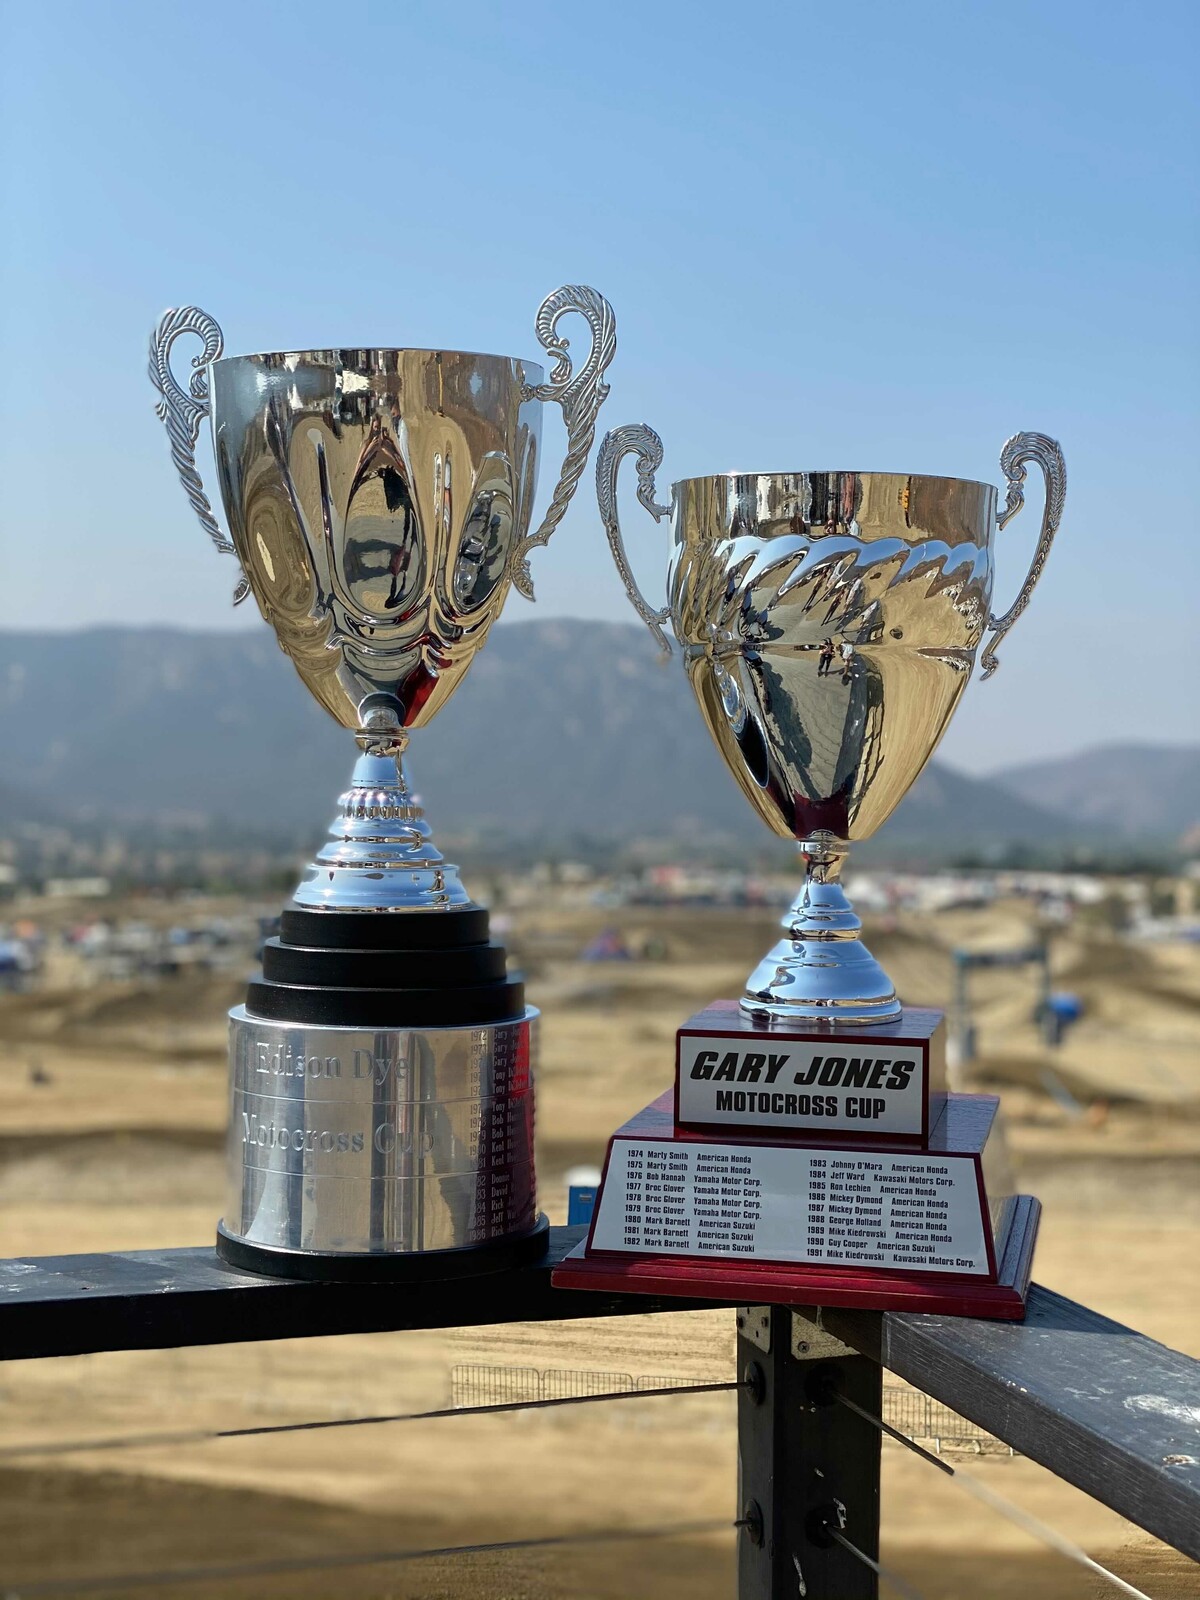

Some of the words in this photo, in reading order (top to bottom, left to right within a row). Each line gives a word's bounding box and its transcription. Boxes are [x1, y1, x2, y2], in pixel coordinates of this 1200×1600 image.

[471, 1030, 486, 1041] 1972
[256, 1042, 342, 1079] Edison
[353, 1049, 410, 1085] Dye
[493, 1056, 507, 1067] Gary
[492, 1070, 505, 1081] Tony
[690, 1051, 790, 1083] GARY
[793, 1056, 915, 1090] JONES
[492, 1084, 505, 1094] Tony
[492, 1101, 505, 1112] Tony
[716, 1090, 838, 1117] MOTOCROSS
[845, 1097, 885, 1119] CUP
[492, 1114, 503, 1125] Bob
[242, 1112, 364, 1153] Motocross
[375, 1123, 435, 1154] Cup
[492, 1128, 503, 1139] Bob
[492, 1141, 504, 1152] Kent
[492, 1154, 504, 1166] Kent
[628, 1150, 643, 1158] 1974
[647, 1151, 667, 1160] Marty
[669, 1152, 688, 1160] Smith
[697, 1153, 729, 1162] American
[731, 1155, 751, 1163] Honda
[647, 1161, 667, 1171] Marty
[669, 1163, 688, 1171] Smith
[696, 1164, 728, 1173] American
[730, 1166, 751, 1174] Honda
[810, 1159, 827, 1167] 1983
[831, 1160, 855, 1170] Johnny
[857, 1162, 882, 1170] O'Mara
[891, 1164, 924, 1173] American
[927, 1166, 948, 1174] Honda
[627, 1171, 642, 1179] 1976
[647, 1172, 659, 1180] Bob
[661, 1173, 685, 1181] Hannah
[694, 1175, 719, 1183] Yamaha
[721, 1176, 742, 1185] Motor
[744, 1178, 762, 1187] Corp.
[809, 1170, 826, 1178] 1984
[846, 1172, 865, 1181] Ward
[874, 1174, 907, 1183] Kawasaki
[909, 1176, 934, 1185] Motors
[936, 1177, 955, 1187] Corp.
[492, 1184, 508, 1197] David
[626, 1182, 641, 1190] 1977
[645, 1183, 661, 1191] Broc
[663, 1184, 685, 1192] Glover
[693, 1186, 719, 1195] Yamaha
[721, 1187, 741, 1196] Motor
[743, 1189, 761, 1198] Corp.
[809, 1181, 826, 1190] 1985
[830, 1182, 843, 1190] Ron
[845, 1183, 871, 1192] Lechien
[880, 1185, 913, 1195] American
[915, 1187, 936, 1196] Honda
[492, 1198, 504, 1210] Rick
[626, 1193, 641, 1201] 1978
[646, 1194, 662, 1202] Broc
[663, 1195, 685, 1204] Glover
[694, 1197, 719, 1206] Yamaha
[721, 1198, 742, 1207] Motor
[744, 1200, 762, 1209] Corp.
[809, 1193, 826, 1201] 1986
[830, 1194, 854, 1204] Mickey
[856, 1195, 883, 1204] Dymond
[892, 1197, 925, 1207] American
[927, 1199, 948, 1208] Honda
[491, 1211, 504, 1224] Jeff
[625, 1204, 641, 1212] 1979
[645, 1205, 661, 1213] Broc
[663, 1206, 685, 1215] Glover
[693, 1208, 719, 1217] Yamaha
[721, 1209, 741, 1218] Motor
[743, 1211, 762, 1220] Corp.
[808, 1204, 824, 1212] 1987
[829, 1205, 853, 1215] Mickey
[855, 1206, 881, 1215] Dymond
[890, 1209, 924, 1218] American
[926, 1211, 947, 1219] Honda
[625, 1215, 641, 1223] 1980
[645, 1216, 663, 1224] Mark
[665, 1217, 690, 1226] Barnett
[699, 1219, 731, 1228] American
[733, 1221, 755, 1230] Suzuki
[808, 1215, 825, 1223] 1988
[829, 1216, 854, 1226] George
[856, 1218, 881, 1227] Holland
[890, 1220, 923, 1229] American
[926, 1222, 947, 1231] Honda
[470, 1229, 486, 1241] 1986
[492, 1225, 504, 1237] Rick
[624, 1226, 639, 1234] 1981
[643, 1227, 661, 1235] Mark
[663, 1228, 688, 1237] Barnett
[697, 1230, 729, 1239] American
[731, 1232, 753, 1241] Suzuki
[808, 1226, 824, 1234] 1989
[829, 1227, 845, 1236] Mike
[847, 1228, 886, 1238] Kiedrowski
[895, 1231, 928, 1241] American
[931, 1234, 952, 1242] Honda
[624, 1237, 640, 1245] 1982
[644, 1238, 662, 1246] Mark
[664, 1239, 689, 1248] Barnett
[698, 1242, 730, 1251] American
[732, 1243, 754, 1252] Suzuki
[807, 1237, 824, 1245] 1990
[828, 1238, 841, 1248] Guy
[843, 1239, 868, 1249] Cooper
[877, 1242, 910, 1251] American
[912, 1244, 935, 1253] Suzuki
[807, 1248, 822, 1257] 1991
[827, 1250, 843, 1258] Mike
[845, 1251, 884, 1261] Kiedrowski
[893, 1254, 927, 1264] Kawasaki
[929, 1256, 954, 1266] Motors
[956, 1258, 975, 1268] Corp.
